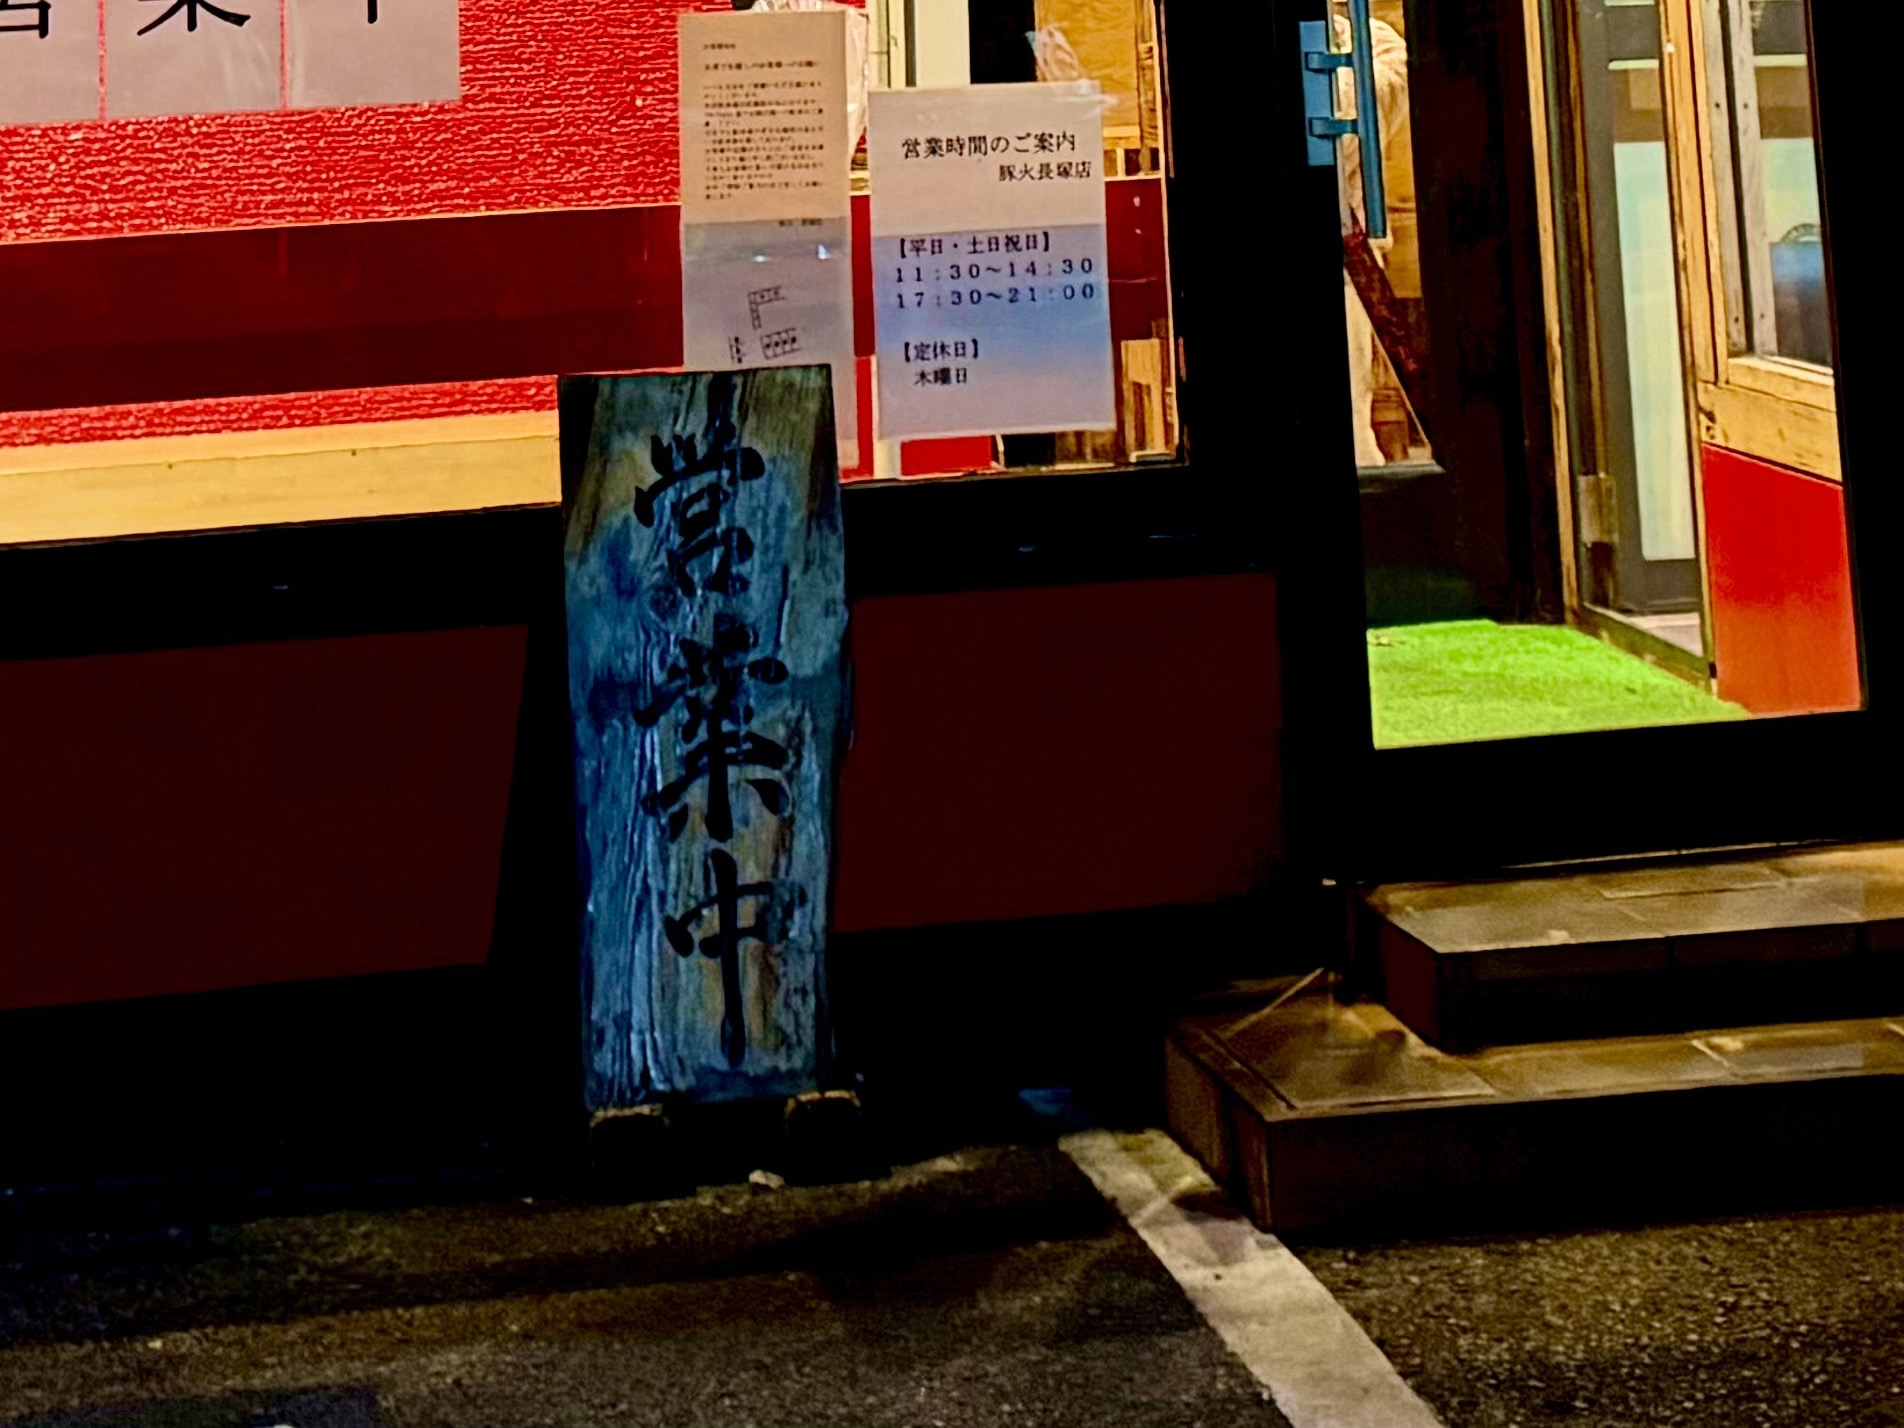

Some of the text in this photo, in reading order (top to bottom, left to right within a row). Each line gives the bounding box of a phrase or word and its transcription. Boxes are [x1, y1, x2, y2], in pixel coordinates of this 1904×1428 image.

[901, 130, 1076, 160] 営業時間のご案内
[913, 367, 969, 387] 木曜日
[633, 432, 805, 1069] 営業中
